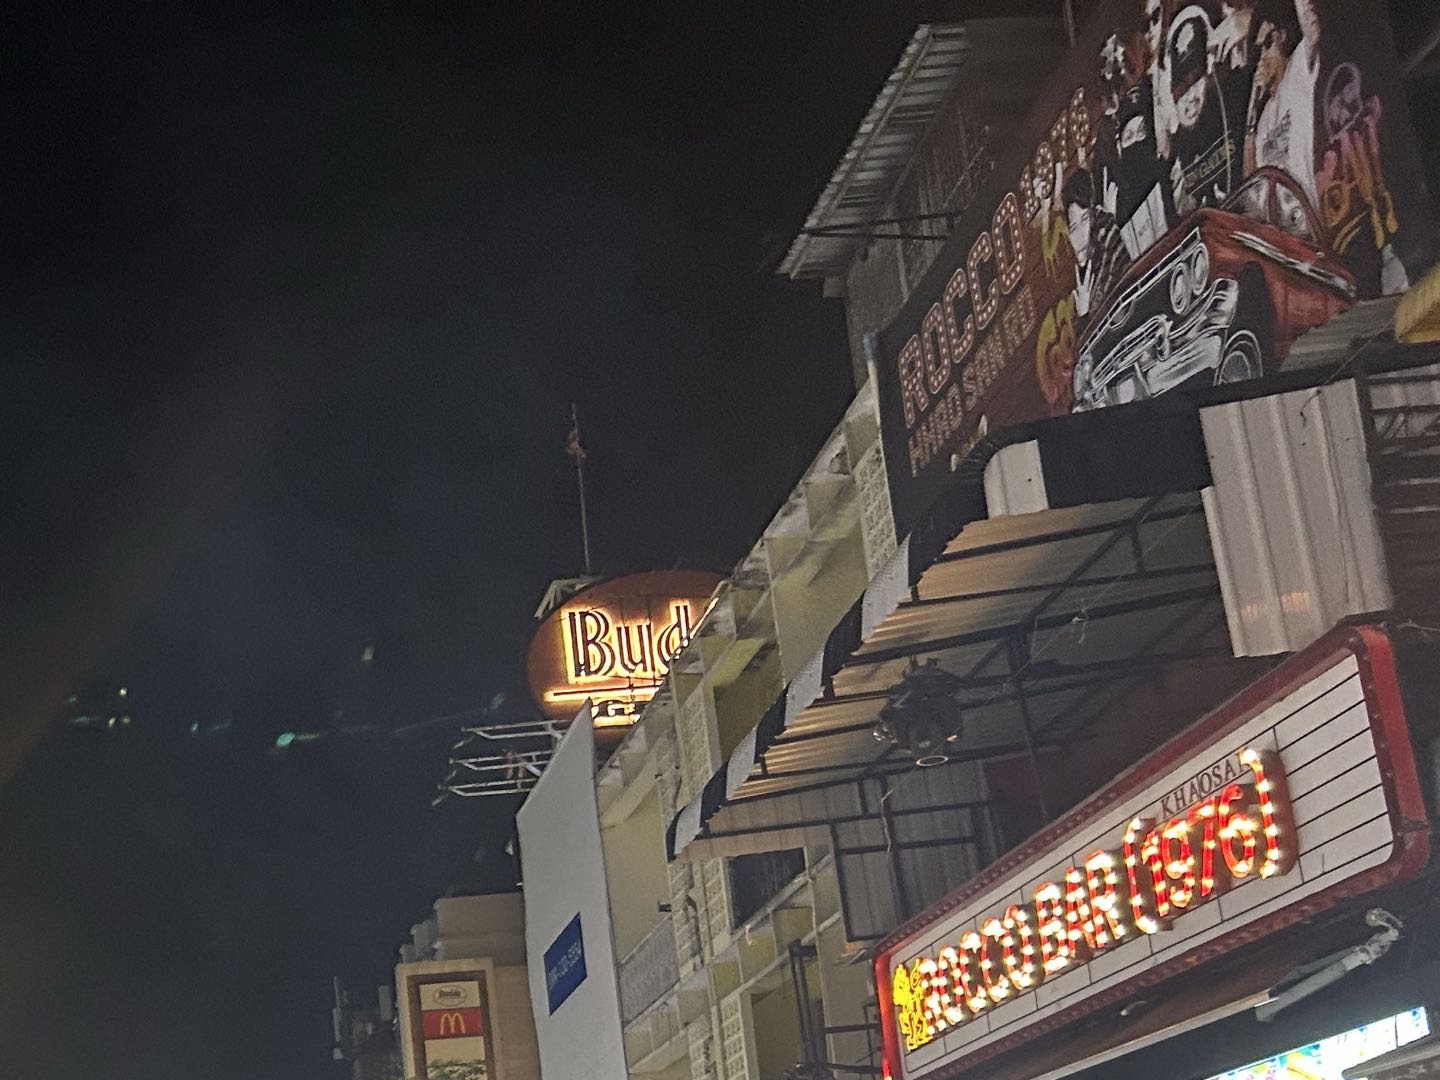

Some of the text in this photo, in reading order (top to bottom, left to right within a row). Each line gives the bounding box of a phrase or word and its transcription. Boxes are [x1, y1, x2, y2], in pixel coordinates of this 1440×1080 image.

[899, 193, 1026, 429] ROCCO
[919, 749, 1280, 1036] ROCCO BAR (1976)
